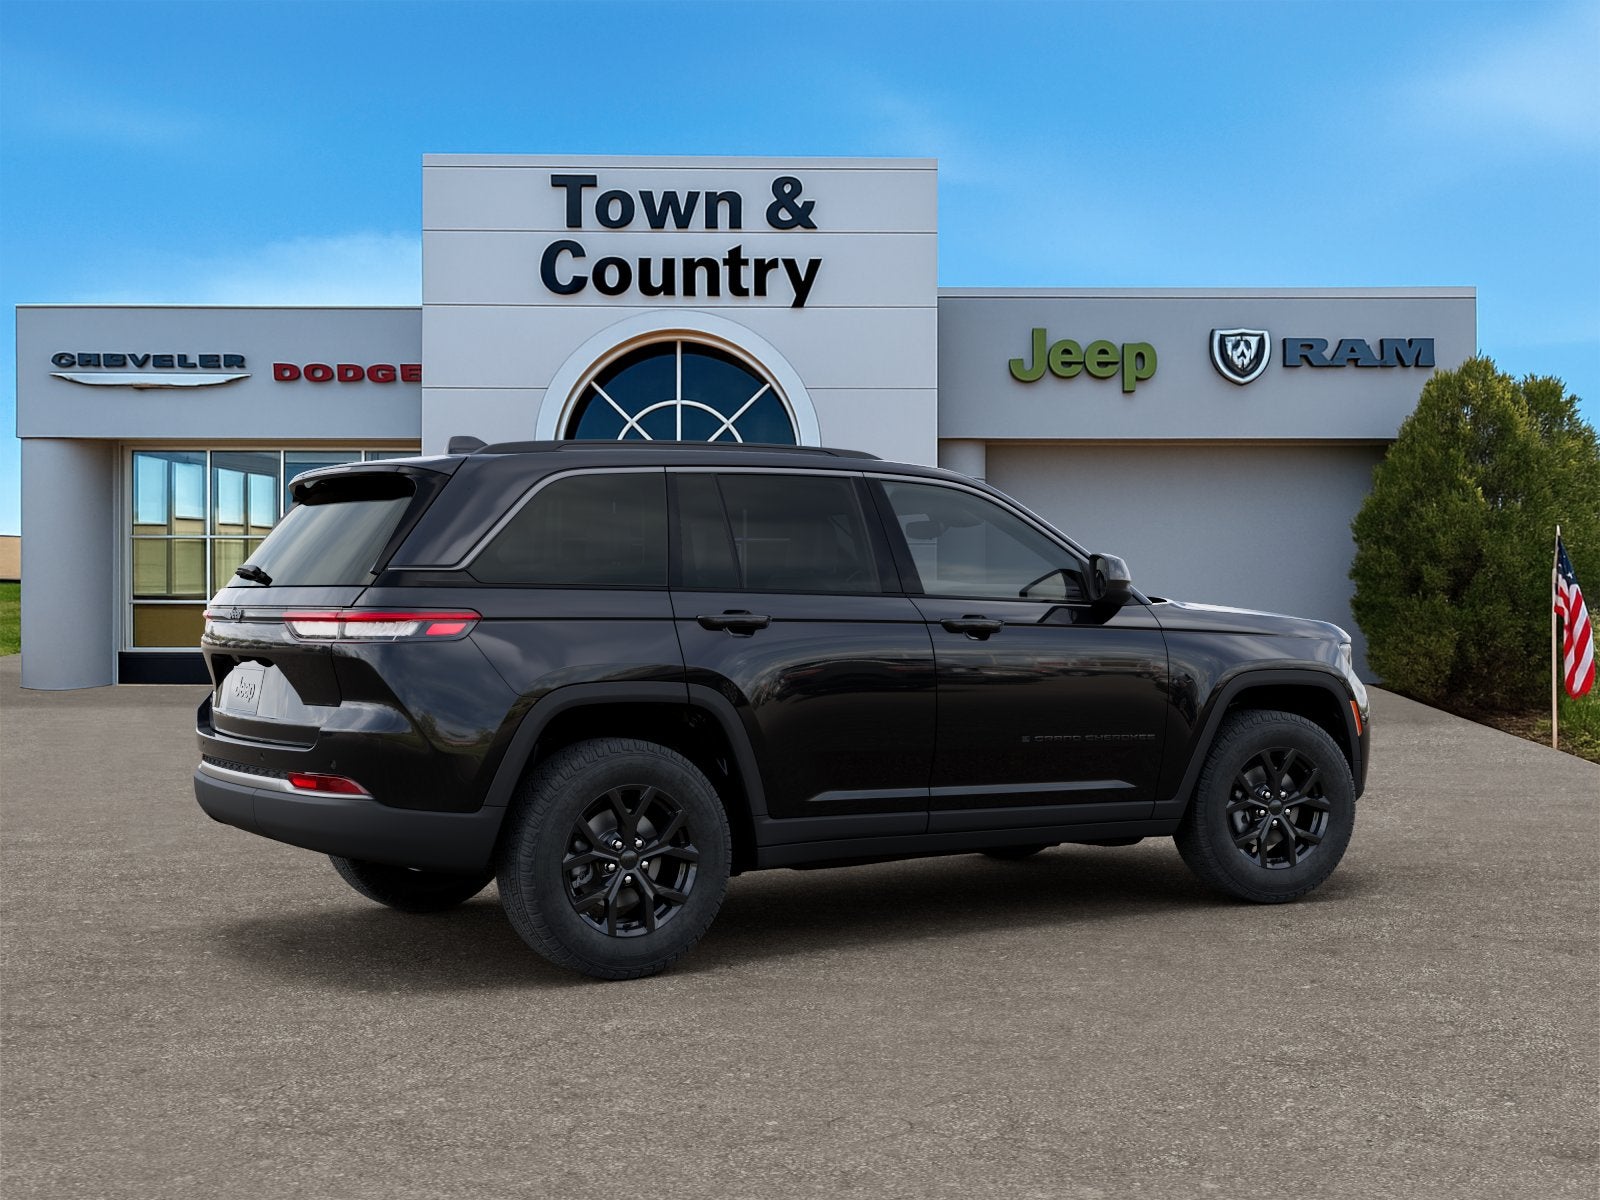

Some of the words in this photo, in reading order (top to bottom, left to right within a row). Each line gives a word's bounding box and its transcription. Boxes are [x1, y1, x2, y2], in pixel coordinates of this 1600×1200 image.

[551, 174, 742, 229] Town
[766, 176, 817, 229] &
[540, 240, 822, 308] Country
[273, 363, 422, 383] DODGE
[1009, 328, 1157, 393] Jeep
[1282, 337, 1435, 367] RAM
